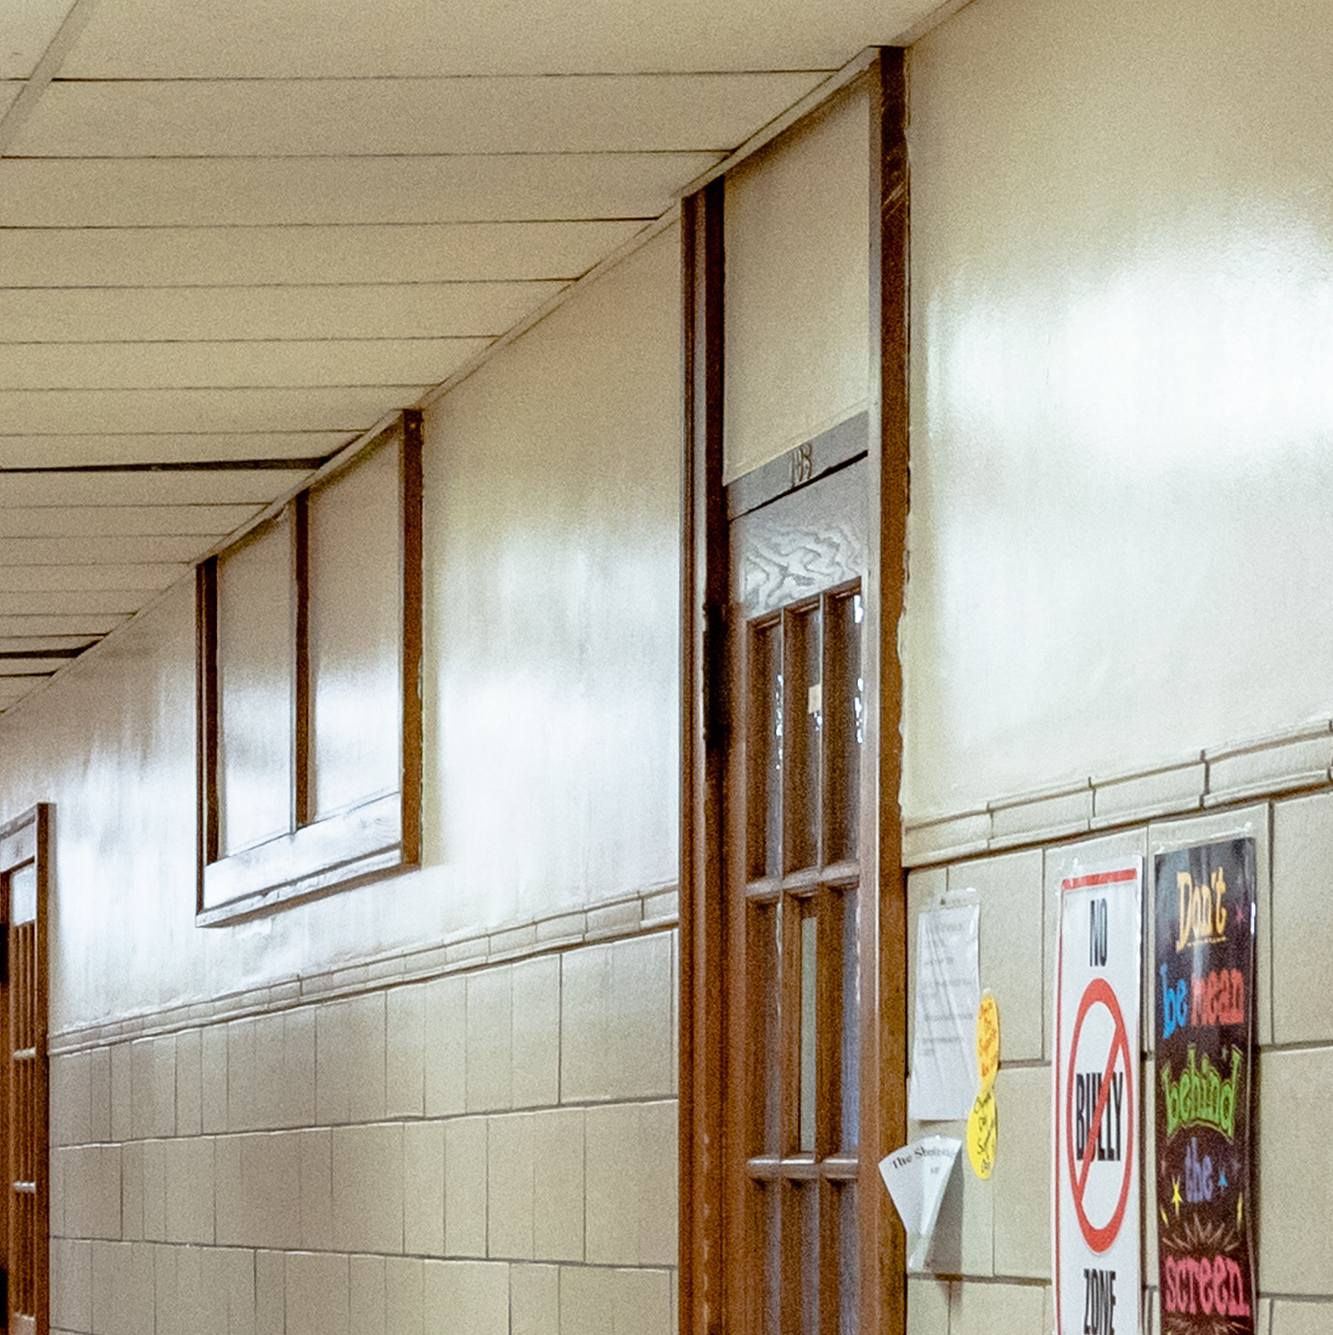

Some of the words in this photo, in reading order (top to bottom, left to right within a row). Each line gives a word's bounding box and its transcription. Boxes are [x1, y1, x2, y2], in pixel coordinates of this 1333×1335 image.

[1089, 898, 1108, 967] NO
[1176, 866, 1227, 952] Don't
[1161, 963, 1188, 1039] be
[1191, 968, 1245, 1026] mean
[1076, 1072, 1123, 1161] BULLY
[1162, 1044, 1242, 1138] behind
[1185, 1136, 1213, 1203] the
[1164, 1254, 1251, 1317] screen
